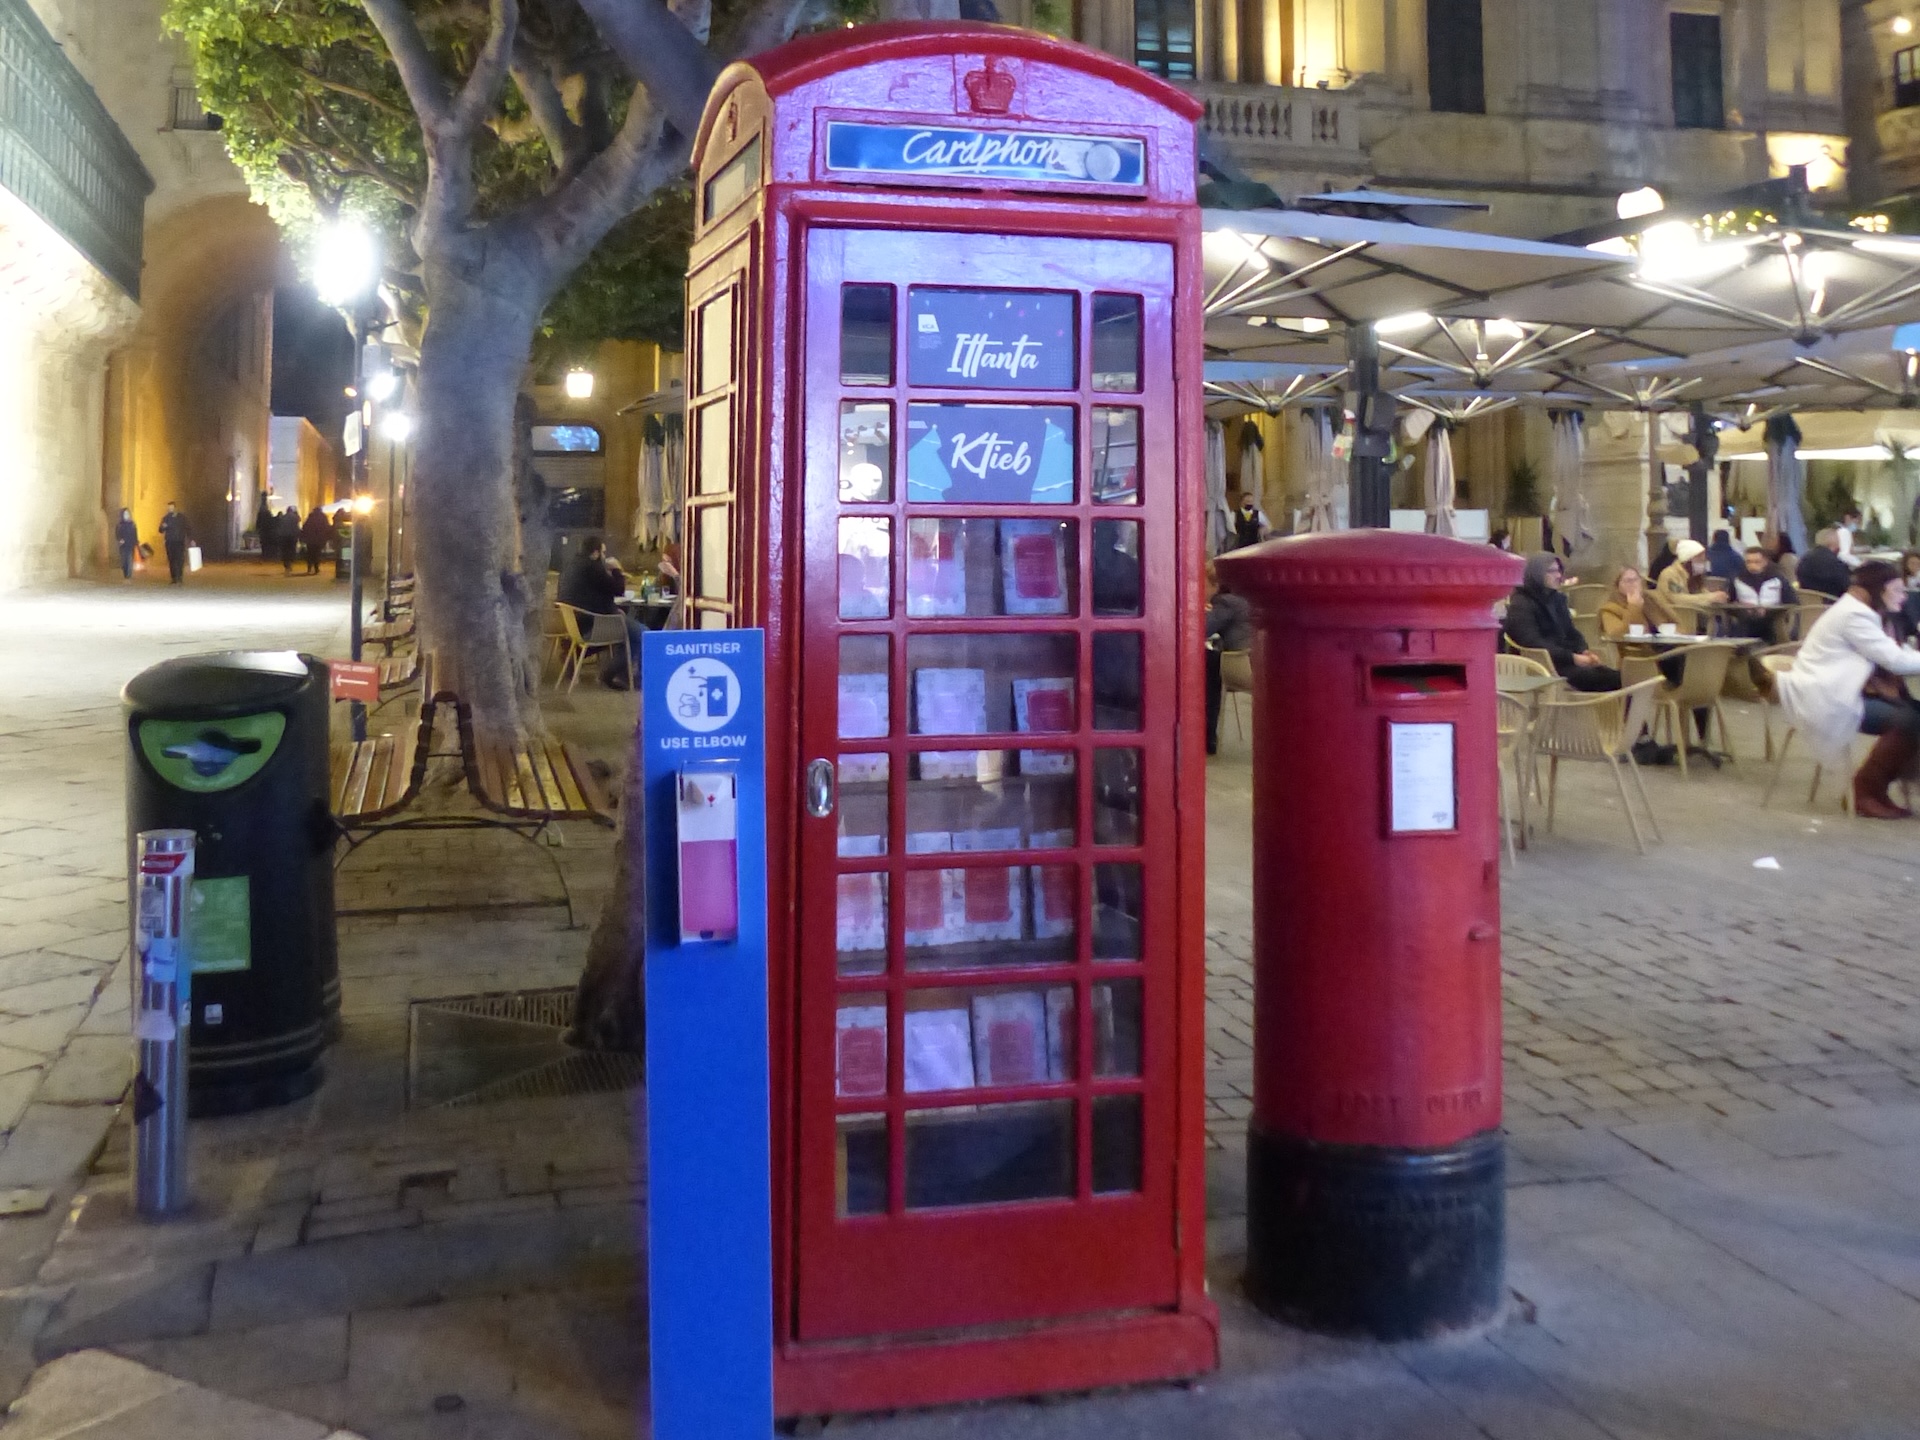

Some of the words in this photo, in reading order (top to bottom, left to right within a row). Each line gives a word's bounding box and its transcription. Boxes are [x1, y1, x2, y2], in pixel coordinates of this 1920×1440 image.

[947, 333, 1043, 378] Ittanta
[951, 431, 1032, 479] Ktieb
[665, 642, 741, 656] SANITISER
[660, 737, 690, 749] USE
[694, 735, 747, 748] ELBOW
